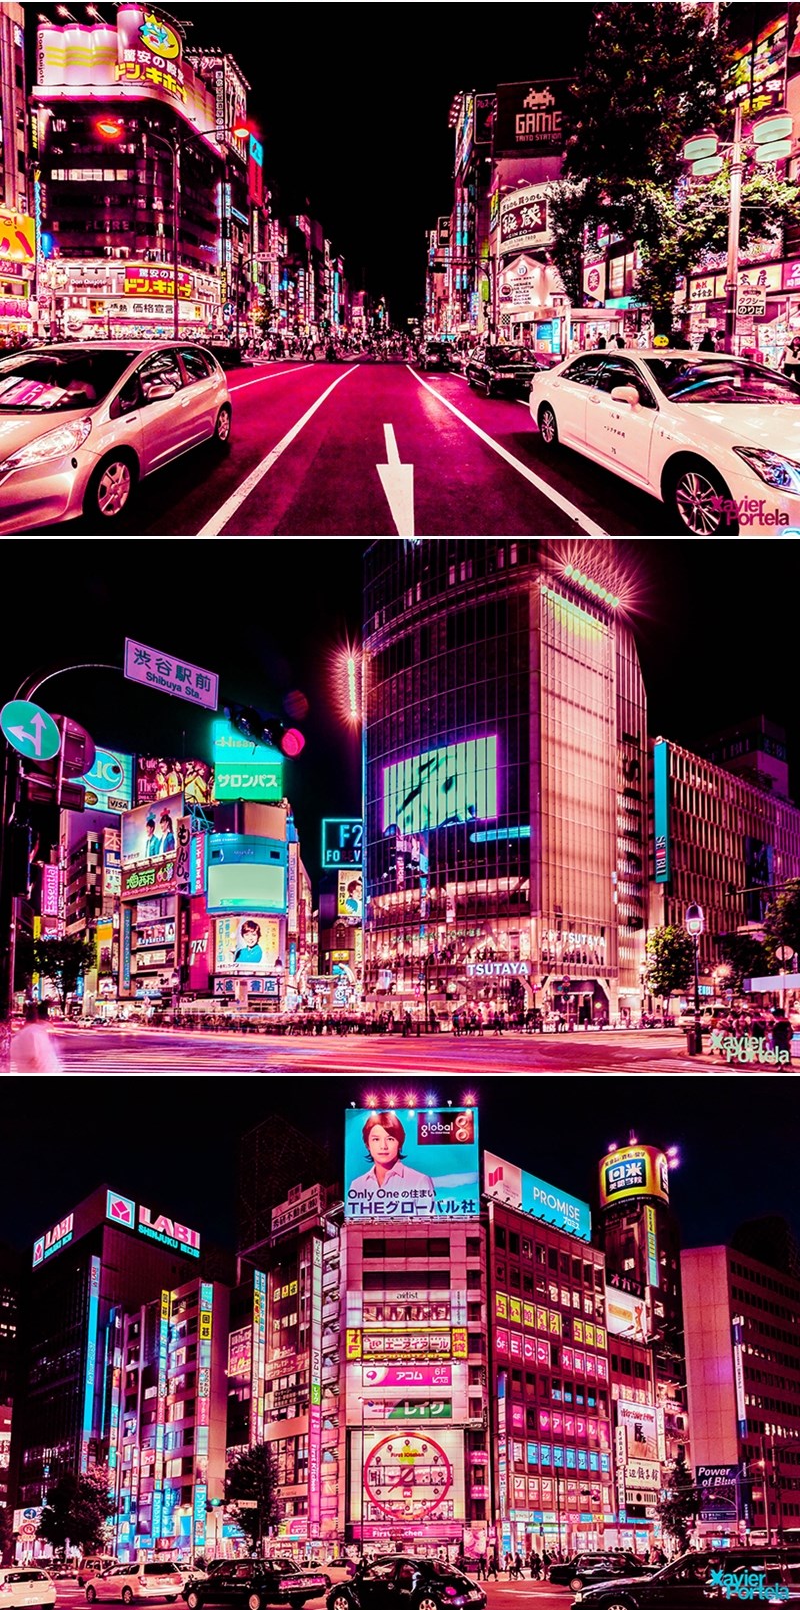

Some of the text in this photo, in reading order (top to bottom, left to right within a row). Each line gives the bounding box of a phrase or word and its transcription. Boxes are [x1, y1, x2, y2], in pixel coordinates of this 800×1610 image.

[516, 111, 562, 133] GAME
[739, 297, 764, 305] タクシー
[133, 304, 173, 313] 価格宣言
[739, 307, 764, 315] のりば
[134, 648, 211, 692] 渋谷駅前
[146, 671, 181, 693] Shibuya
[218, 774, 278, 788] サロンパス
[109, 800, 128, 809] VISA
[467, 963, 529, 977] TSUTAYA
[348, 1189, 373, 1200] Only
[533, 1186, 581, 1221] PROMISE
[45, 1213, 73, 1247] LABI
[139, 1205, 200, 1244] LABI
[698, 1467, 731, 1477] Power
